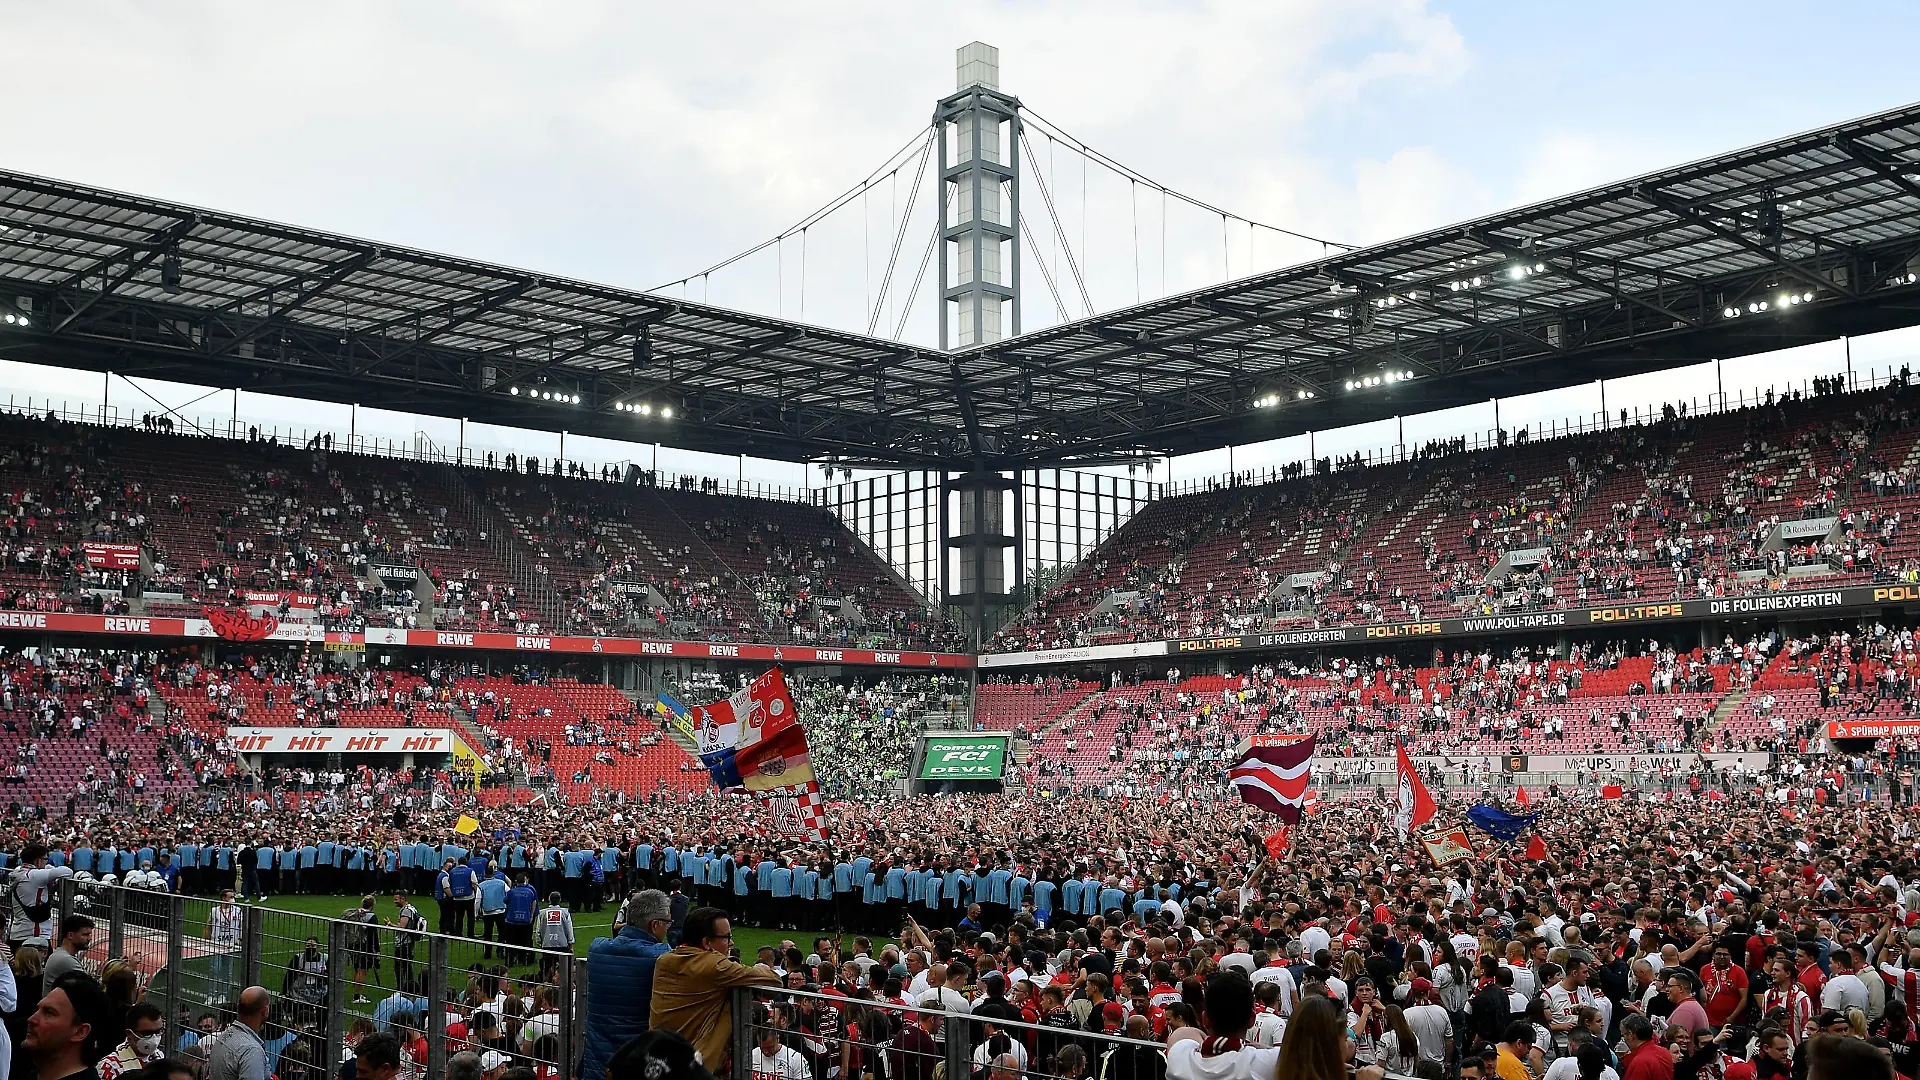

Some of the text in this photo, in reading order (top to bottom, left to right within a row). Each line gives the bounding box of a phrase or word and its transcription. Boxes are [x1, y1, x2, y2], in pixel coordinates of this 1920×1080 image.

[297, 596, 318, 604] BOYZ
[1710, 592, 1841, 613] DIE FOLIENEXPERTEN
[1590, 604, 1682, 621] POLI-TAPE
[104, 618, 150, 632] REWE
[1464, 613, 1565, 631] WWW.POLI-TAPE.DE
[1366, 623, 1441, 637] POLI-TAPE
[437, 633, 473, 645] REWE
[516, 637, 550, 649] REWE
[1180, 638, 1241, 650] POLI-TAPE
[1260, 630, 1345, 646] DIE FOLIENEXPERTEN
[641, 643, 672, 653] REWE
[709, 646, 738, 656] REWE
[816, 650, 842, 660] REWE
[875, 653, 900, 663] REWE
[1851, 725, 1889, 736] SPÜRBAR
[942, 751, 990, 761] FC!
[1587, 758, 1611, 770] UPS
[1615, 758, 1625, 769] in
